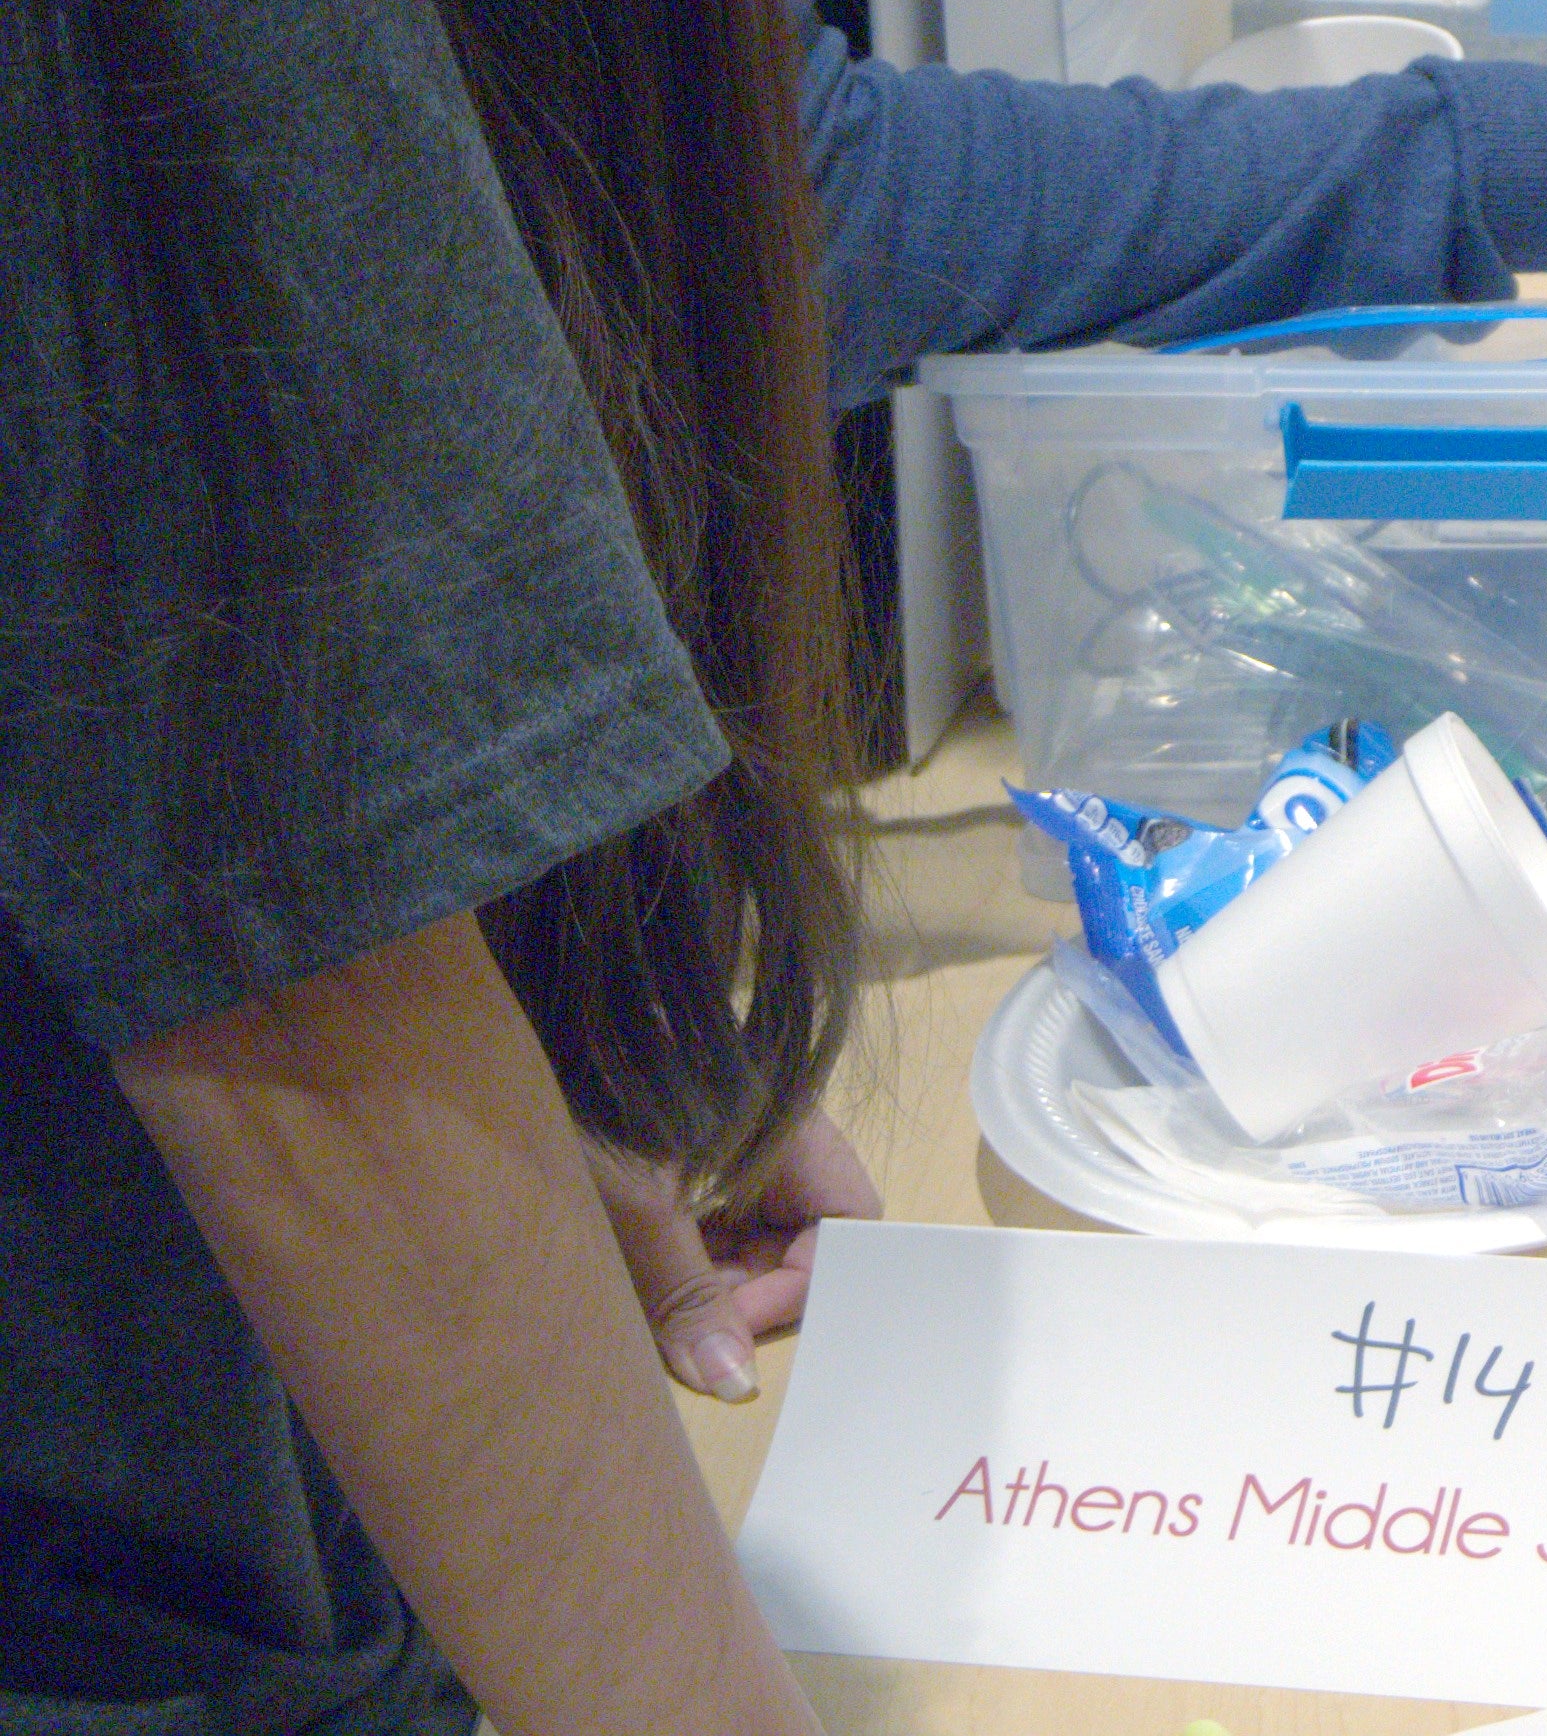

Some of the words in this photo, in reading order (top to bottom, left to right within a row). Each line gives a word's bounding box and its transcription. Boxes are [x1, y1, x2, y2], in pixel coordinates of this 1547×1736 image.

[1333, 1301, 1534, 1439] #14
[938, 1457, 1202, 1537] Athens
[1229, 1474, 1510, 1560] Middle
